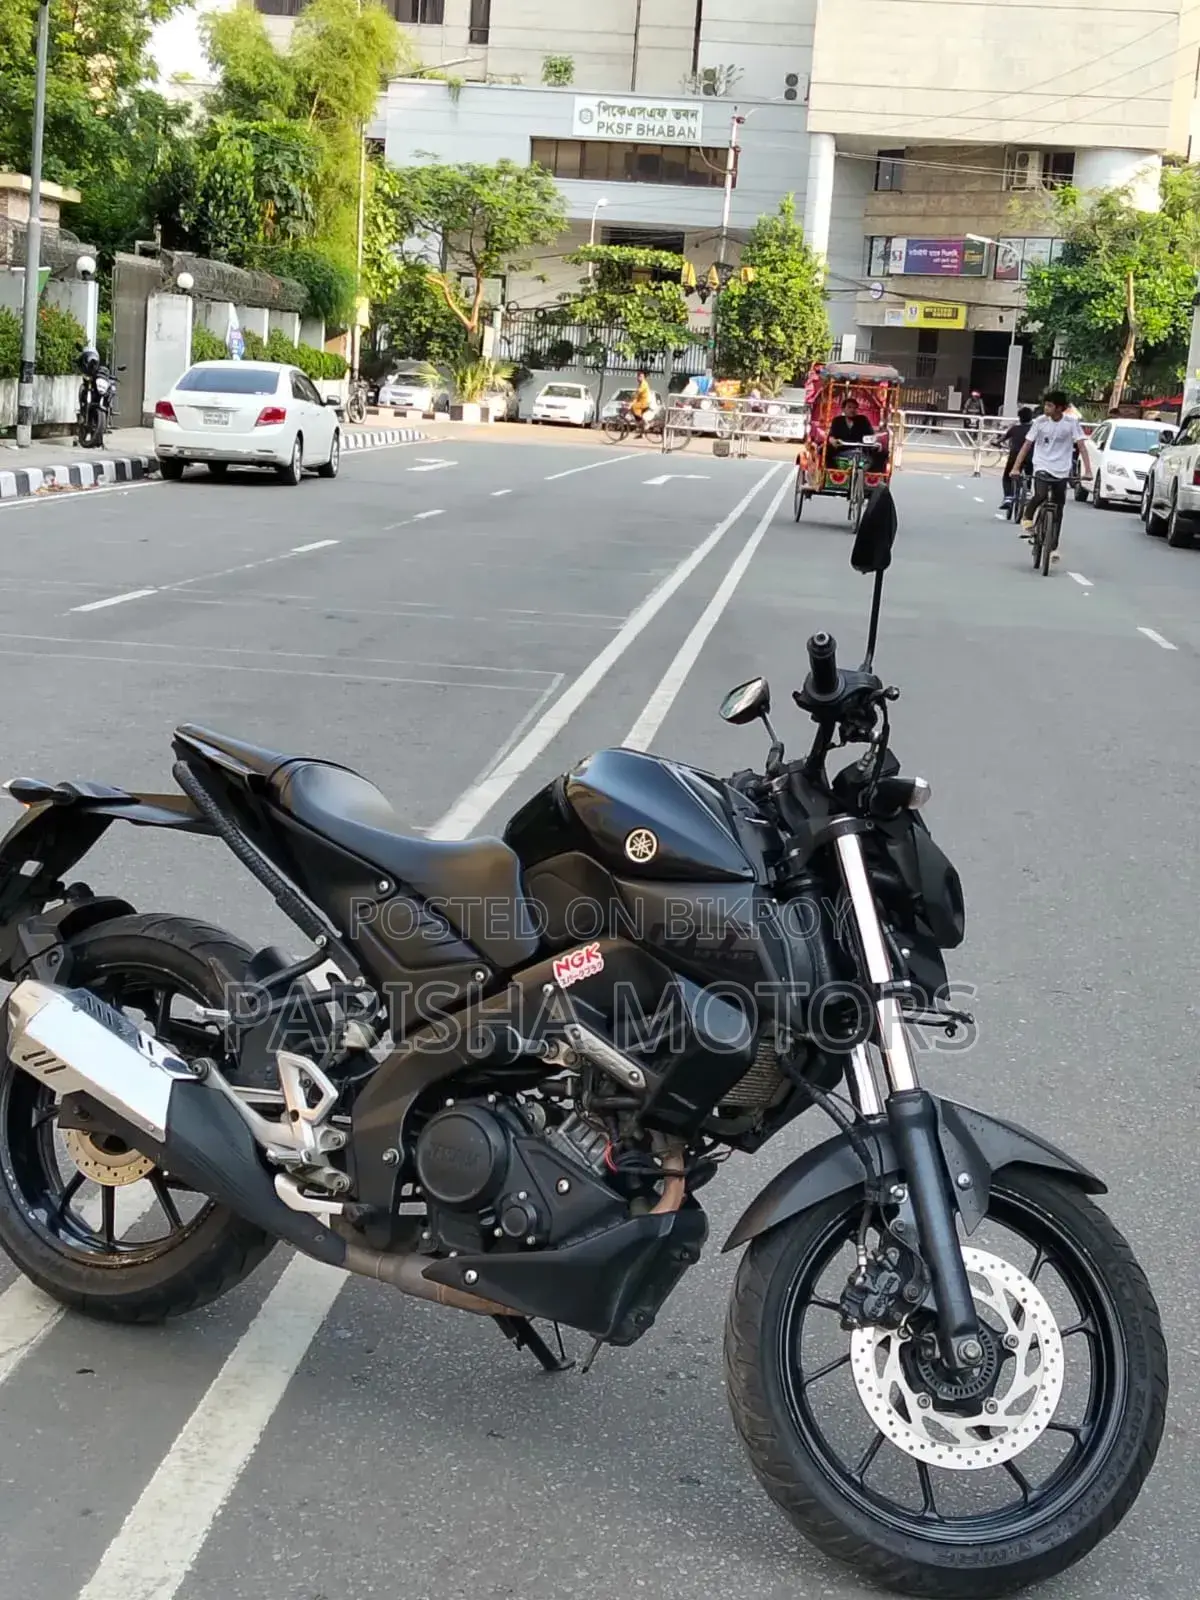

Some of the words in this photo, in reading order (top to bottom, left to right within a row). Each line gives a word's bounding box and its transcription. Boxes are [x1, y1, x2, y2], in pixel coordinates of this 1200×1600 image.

[596, 100, 668, 119] পিকেএসএফ
[671, 108, 699, 122] ভবন
[597, 121, 633, 136] PKSF
[636, 123, 697, 139] BHABAN
[556, 944, 599, 977] NGK
